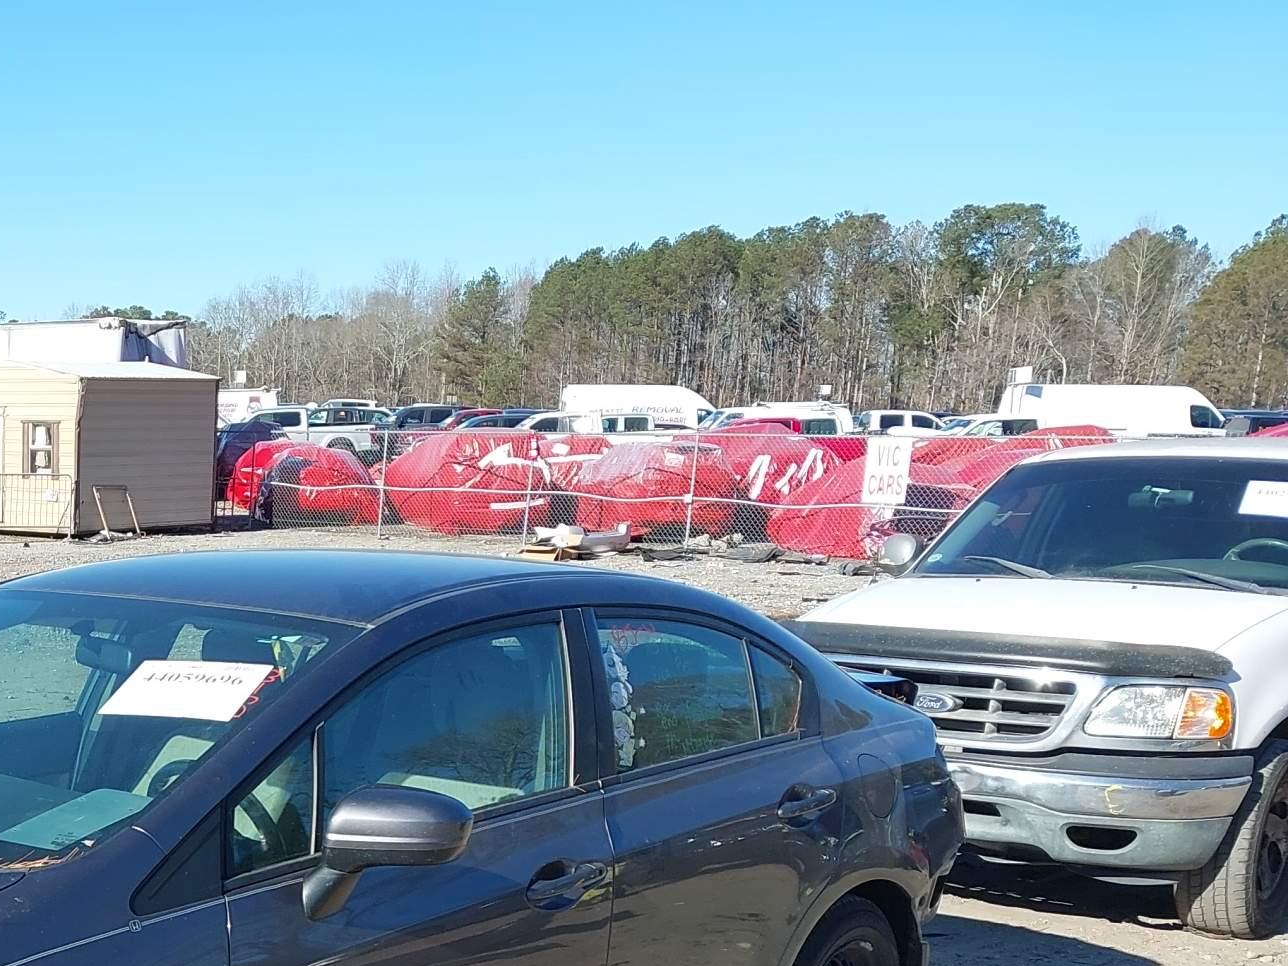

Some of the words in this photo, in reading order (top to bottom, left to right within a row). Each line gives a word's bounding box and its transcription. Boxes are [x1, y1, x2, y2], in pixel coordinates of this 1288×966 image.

[877, 444, 902, 467] VIC
[867, 473, 904, 497] CARS
[143, 671, 245, 686] 44059696
[916, 696, 944, 709] Ford
